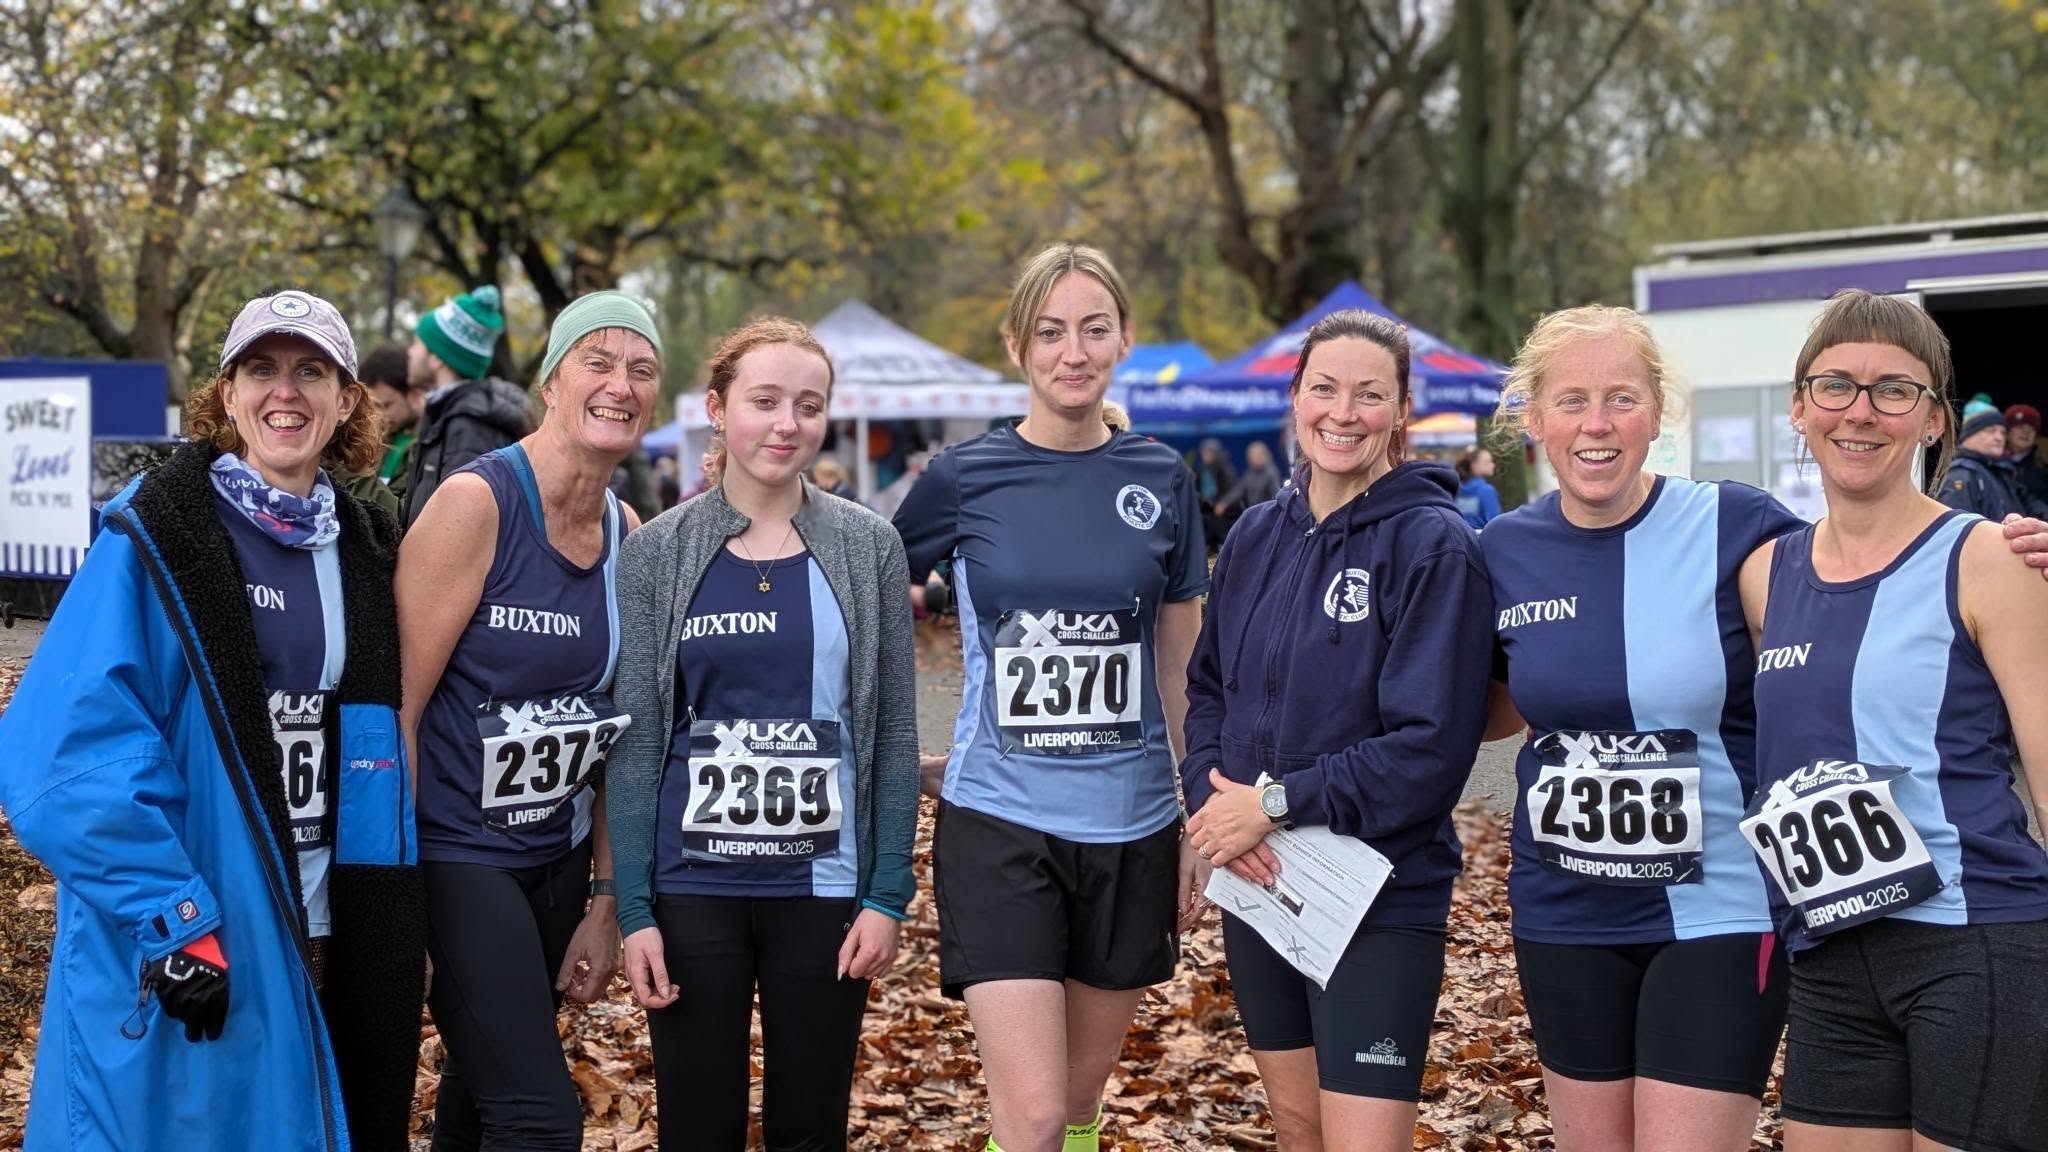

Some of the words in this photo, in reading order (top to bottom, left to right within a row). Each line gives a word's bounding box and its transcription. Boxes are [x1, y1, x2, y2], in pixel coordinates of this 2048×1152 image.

[6, 399, 76, 434] SWEET
[246, 584, 285, 611] TON
[488, 605, 581, 638] BUXTON
[1057, 613, 1120, 632] UKA
[1497, 596, 1578, 631] BUXTON
[681, 611, 778, 641] BUXTON
[1057, 630, 1082, 640] CROSS
[1082, 630, 1120, 641] CHALLENGE
[1758, 643, 1813, 674] TON
[1006, 653, 1130, 717] 2370
[534, 695, 593, 718] UKA
[280, 714, 303, 725] CROSS
[540, 713, 561, 725] CROSS
[560, 711, 598, 722] CHALLENGE
[749, 722, 818, 742] UKA
[1023, 730, 1121, 748] LIVERPOOL2025
[750, 741, 775, 751] CROSS
[775, 740, 818, 751] CHALLENGE
[1592, 734, 1667, 754] UKA
[1598, 752, 1621, 764] CROSS
[1619, 751, 1668, 763] CHALLENGE
[1798, 760, 1870, 782] UKA
[1795, 777, 1818, 793] CROSS
[1818, 772, 1870, 785] CHALLENGE
[692, 764, 831, 827] 2369
[1536, 775, 1689, 846] 2368
[707, 839, 815, 856] LIVERPOOL2025
[1754, 789, 1908, 895] 2366
[1558, 853, 1674, 879] LIVERPOOL2025
[1355, 1052, 1407, 1067] RUNNINGBEAR
